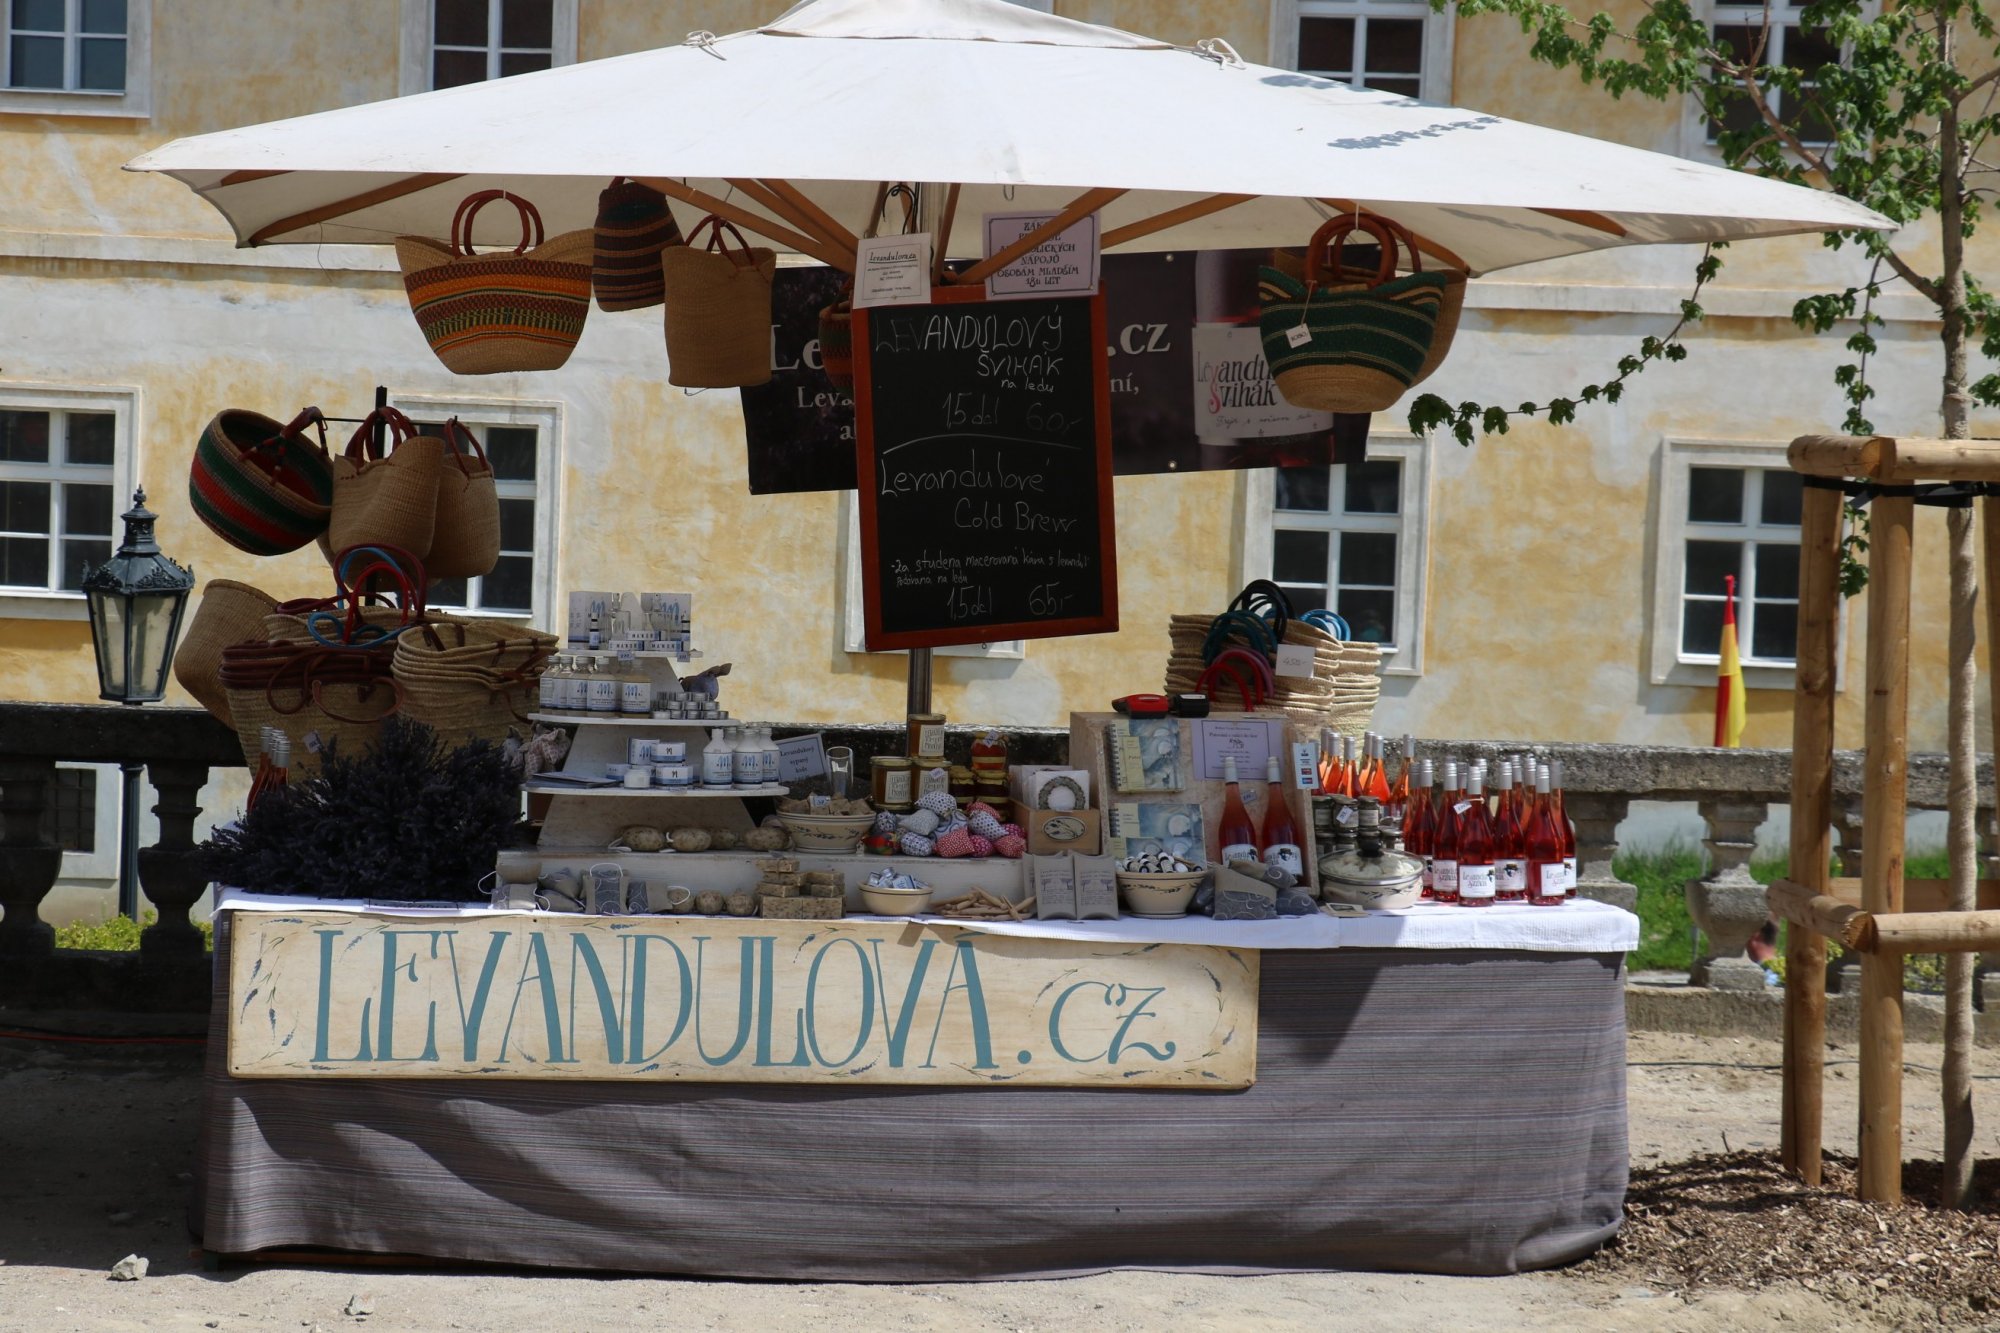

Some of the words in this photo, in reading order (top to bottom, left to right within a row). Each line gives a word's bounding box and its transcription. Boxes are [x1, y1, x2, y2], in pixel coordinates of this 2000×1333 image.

[875, 304, 1063, 352] LEVANDULOVÝ
[1001, 378, 1017, 390] na
[1024, 377, 1055, 393] ledu
[881, 448, 1050, 497] Levandulové
[954, 497, 1003, 529] Cold
[1015, 500, 1077, 532] Brew
